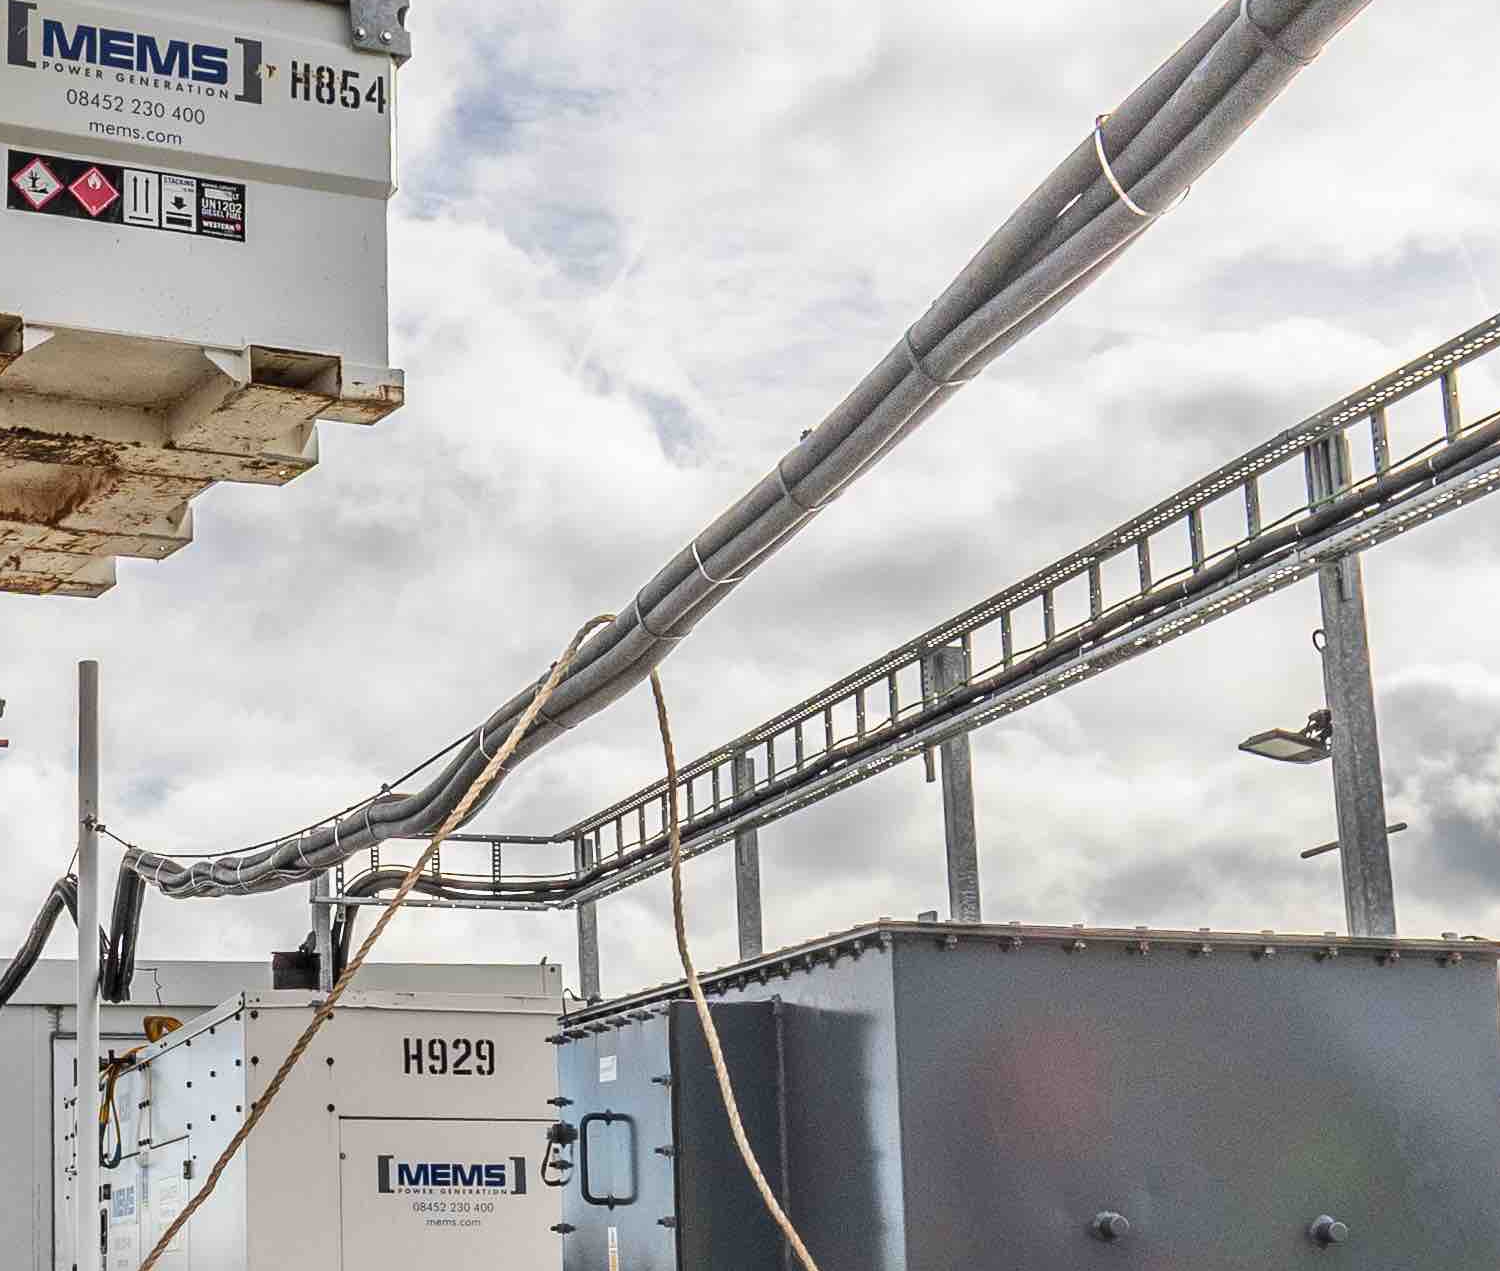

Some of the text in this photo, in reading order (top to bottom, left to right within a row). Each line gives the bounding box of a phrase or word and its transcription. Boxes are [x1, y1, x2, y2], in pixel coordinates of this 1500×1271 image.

[41, 62, 229, 100] POWER GENERATION
[290, 61, 386, 114] H854
[66, 88, 206, 125] 08452 230 400
[89, 120, 183, 146] mems.com
[201, 198, 243, 214] UN1202
[403, 1037, 495, 1076] H929
[397, 1187, 507, 1196] POWER GENERATION
[412, 1202, 494, 1213] 08452 230 400
[426, 1218, 481, 1227] mems.com
